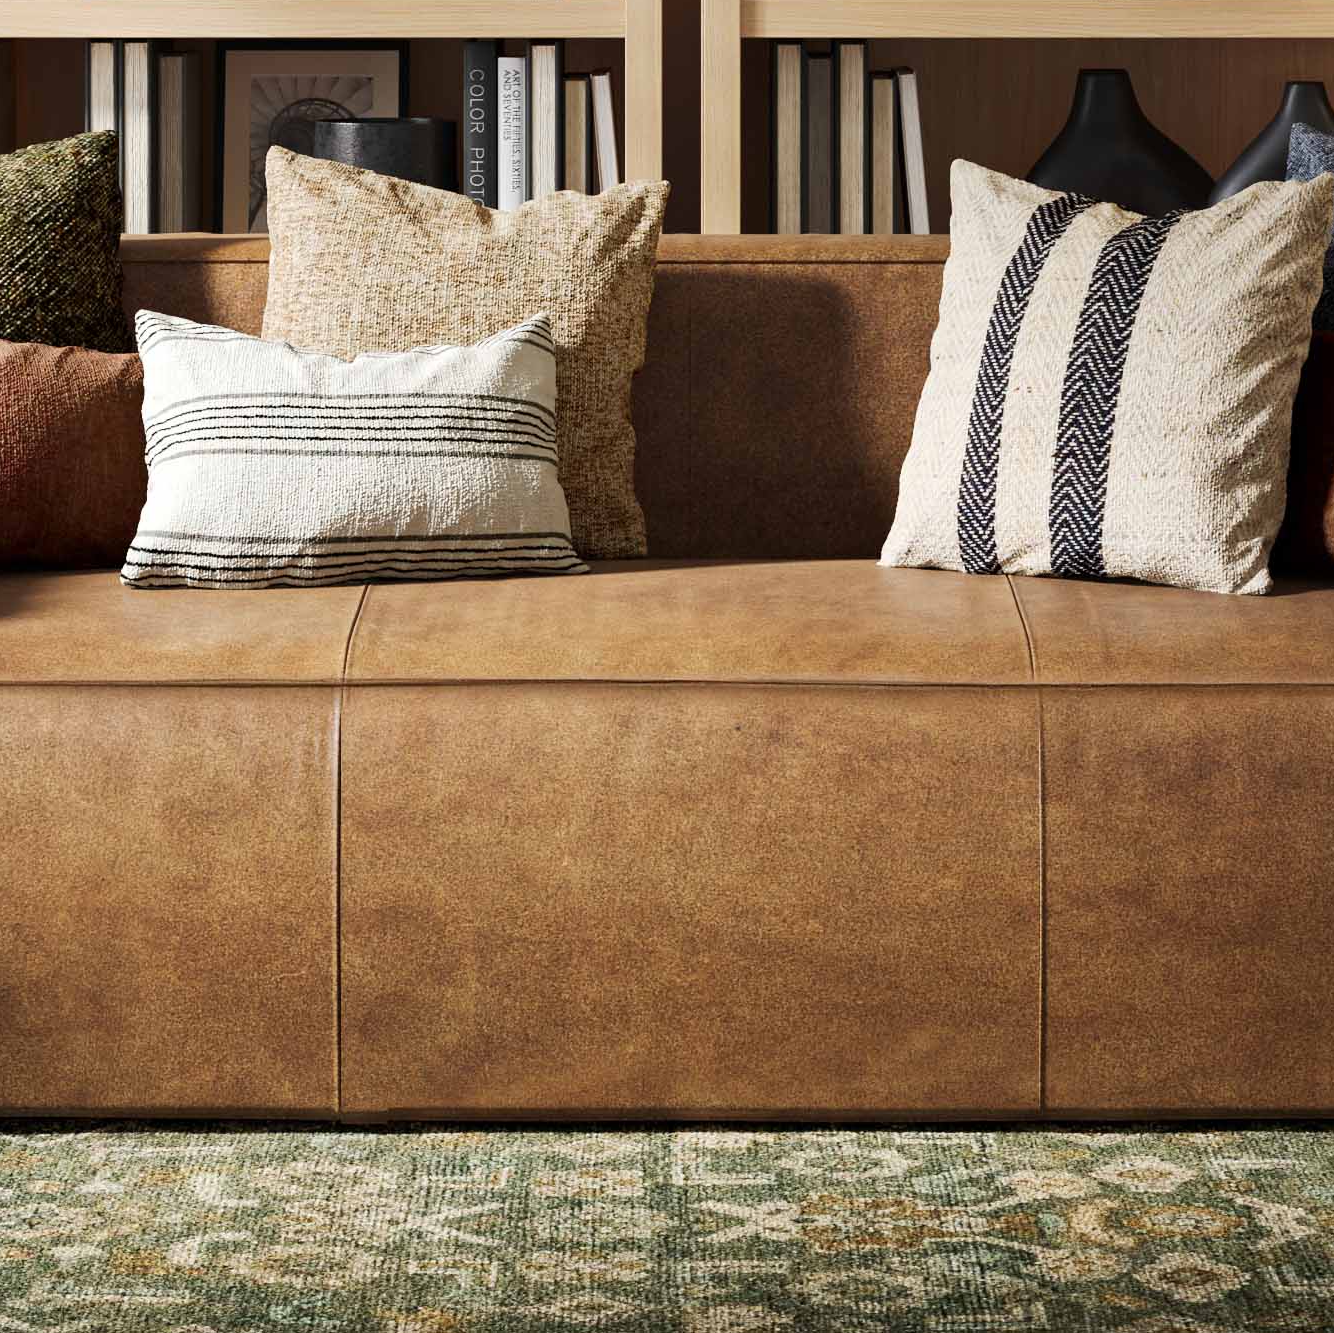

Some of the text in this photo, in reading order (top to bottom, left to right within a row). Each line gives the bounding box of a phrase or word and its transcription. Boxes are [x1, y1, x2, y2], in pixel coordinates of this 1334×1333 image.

[512, 69, 521, 86] ART
[469, 69, 485, 134] COLOR
[512, 90, 521, 101] OF
[503, 69, 511, 141] AND SEVENTIES
[512, 105, 521, 122] THE
